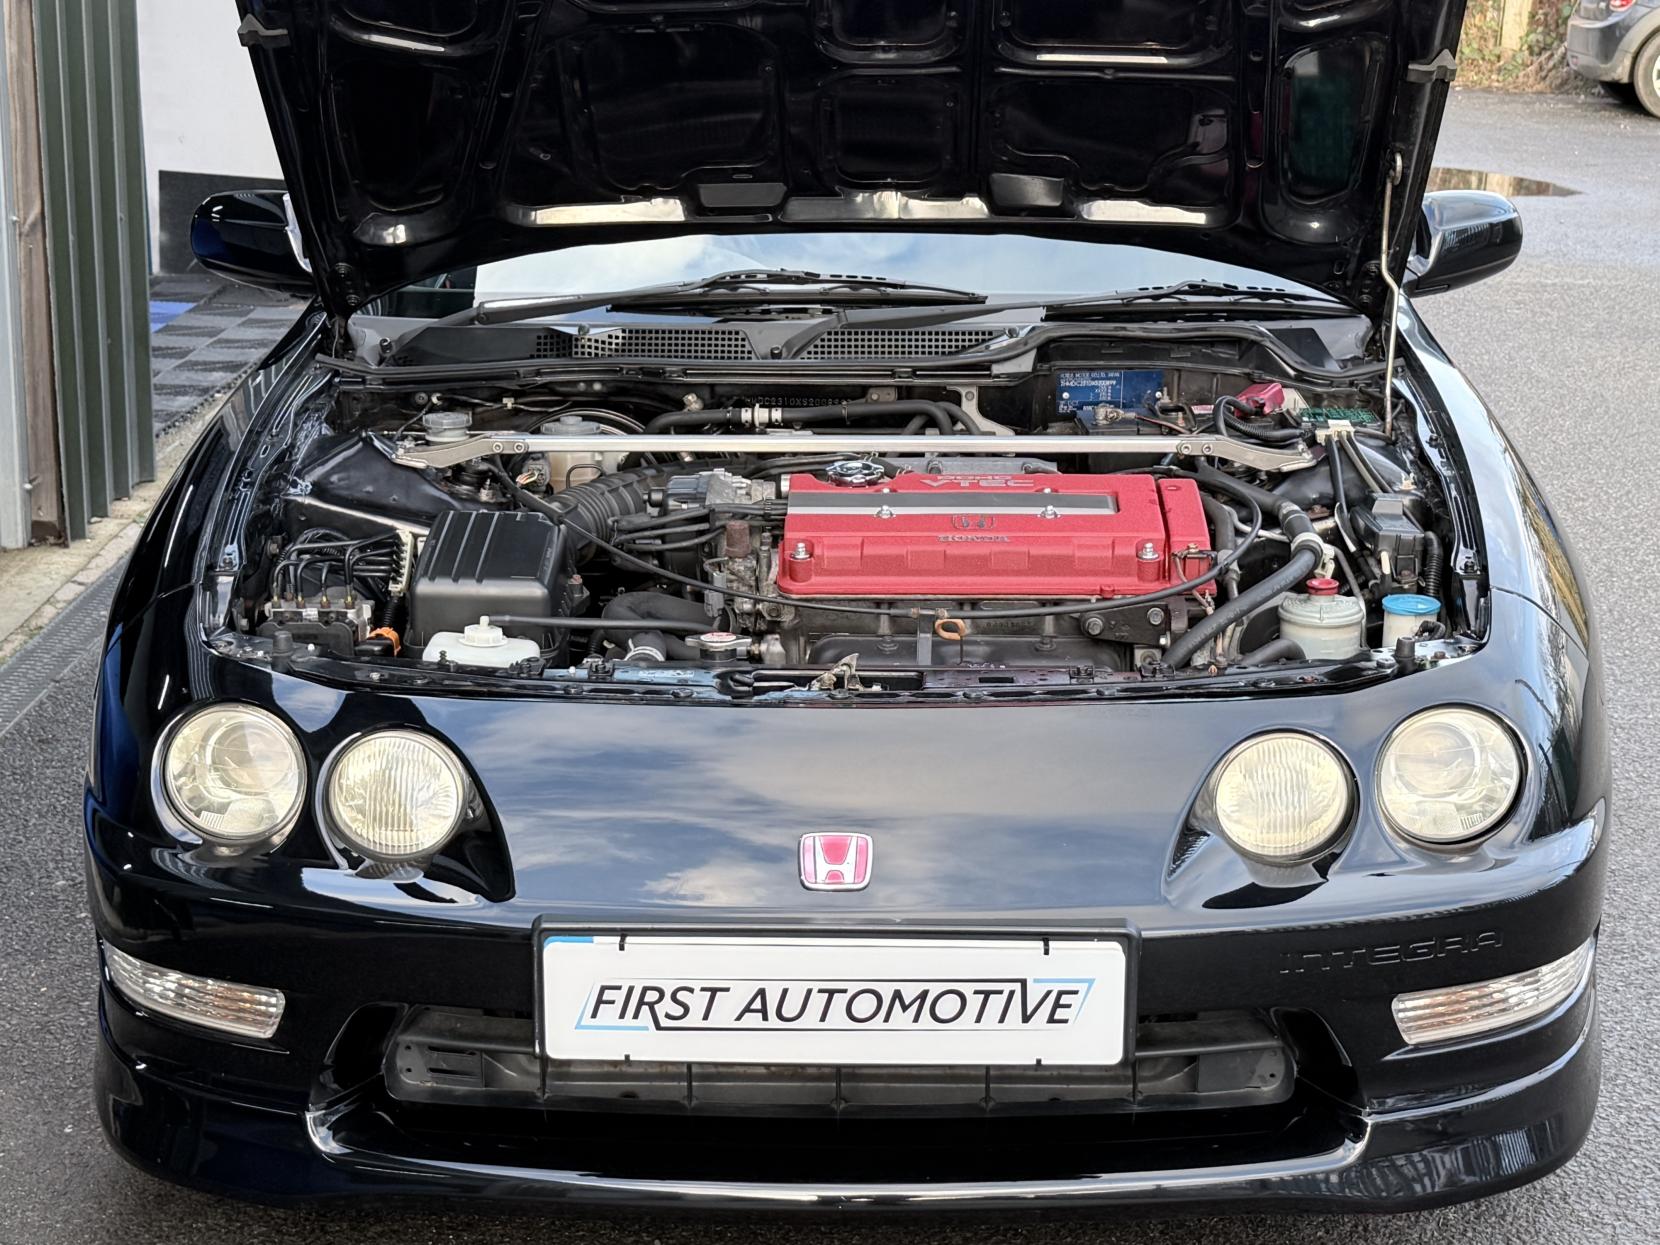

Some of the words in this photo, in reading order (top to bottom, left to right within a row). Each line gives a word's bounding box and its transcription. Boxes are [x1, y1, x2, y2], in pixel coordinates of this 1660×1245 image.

[919, 479, 1034, 487] VTEC
[1280, 931, 1503, 974] INTEGRA
[590, 984, 730, 1022] FIRST
[734, 984, 1079, 1025] AUTOMOTIVE
